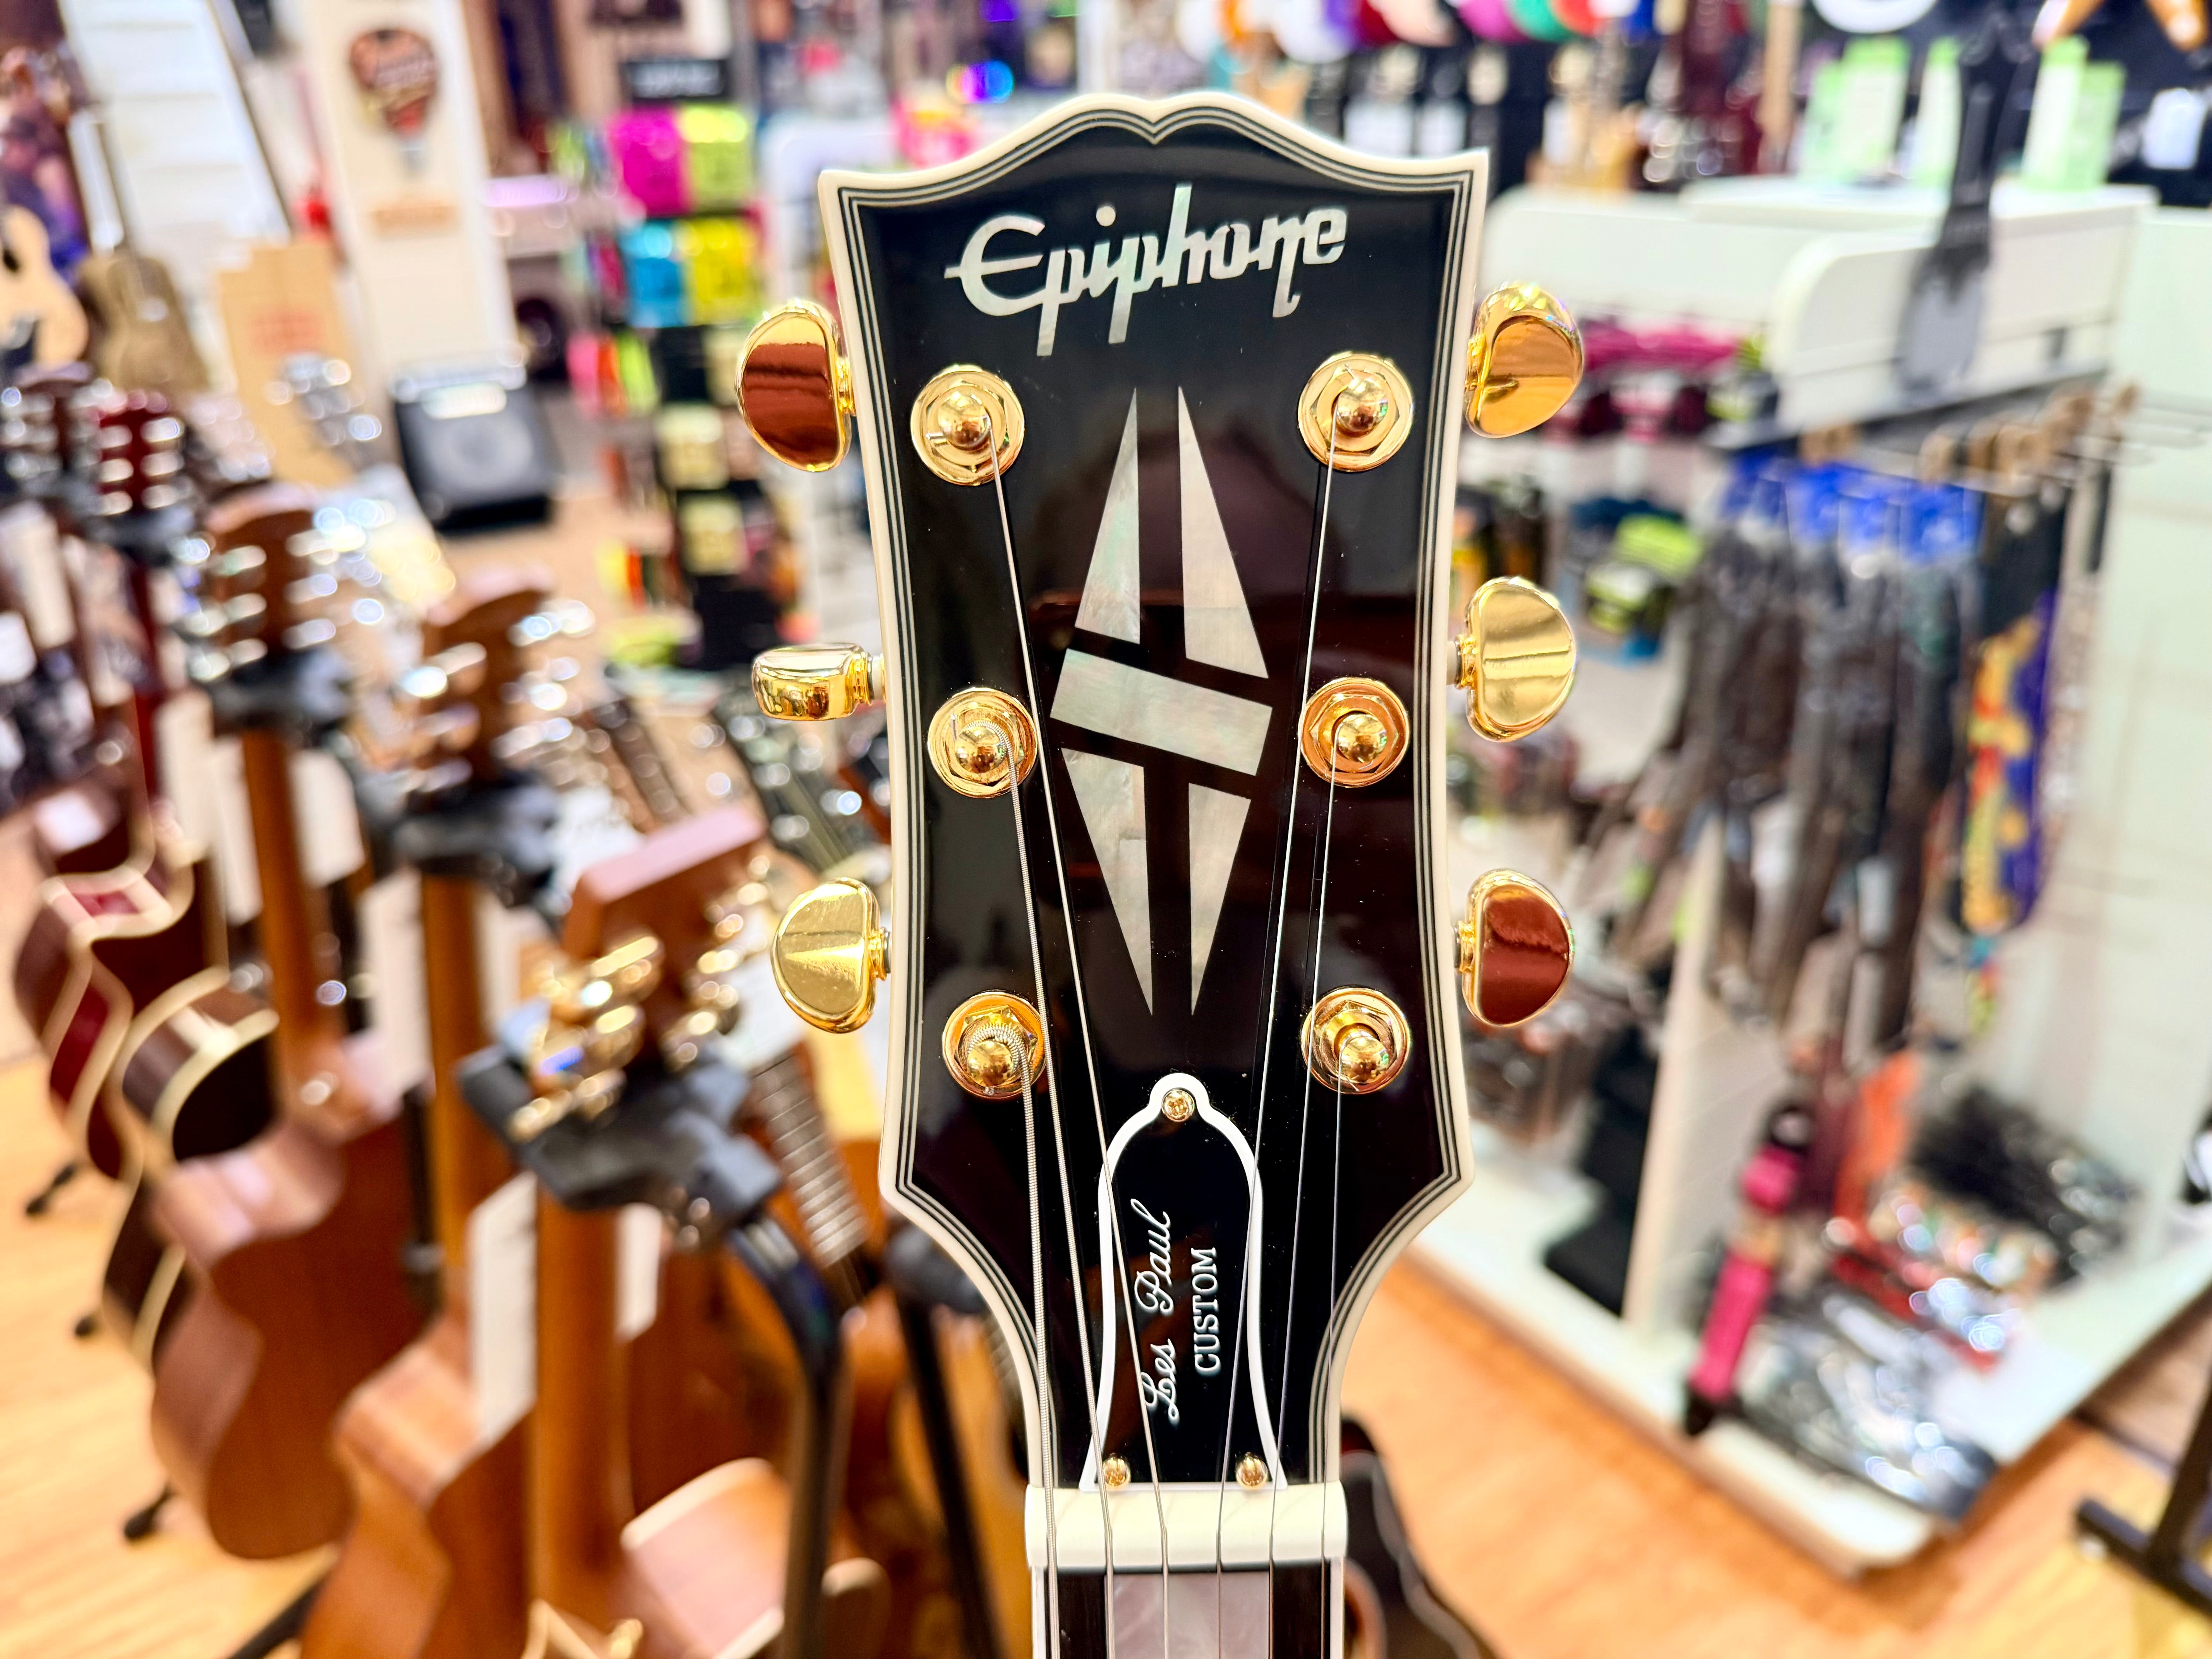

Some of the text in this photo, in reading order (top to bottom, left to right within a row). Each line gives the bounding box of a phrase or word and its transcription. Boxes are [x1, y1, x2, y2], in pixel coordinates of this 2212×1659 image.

[944, 182, 1347, 356] Epiphone
[1130, 1198, 1180, 1424] Les Paul
[1191, 1247, 1220, 1375] CUSTOM
